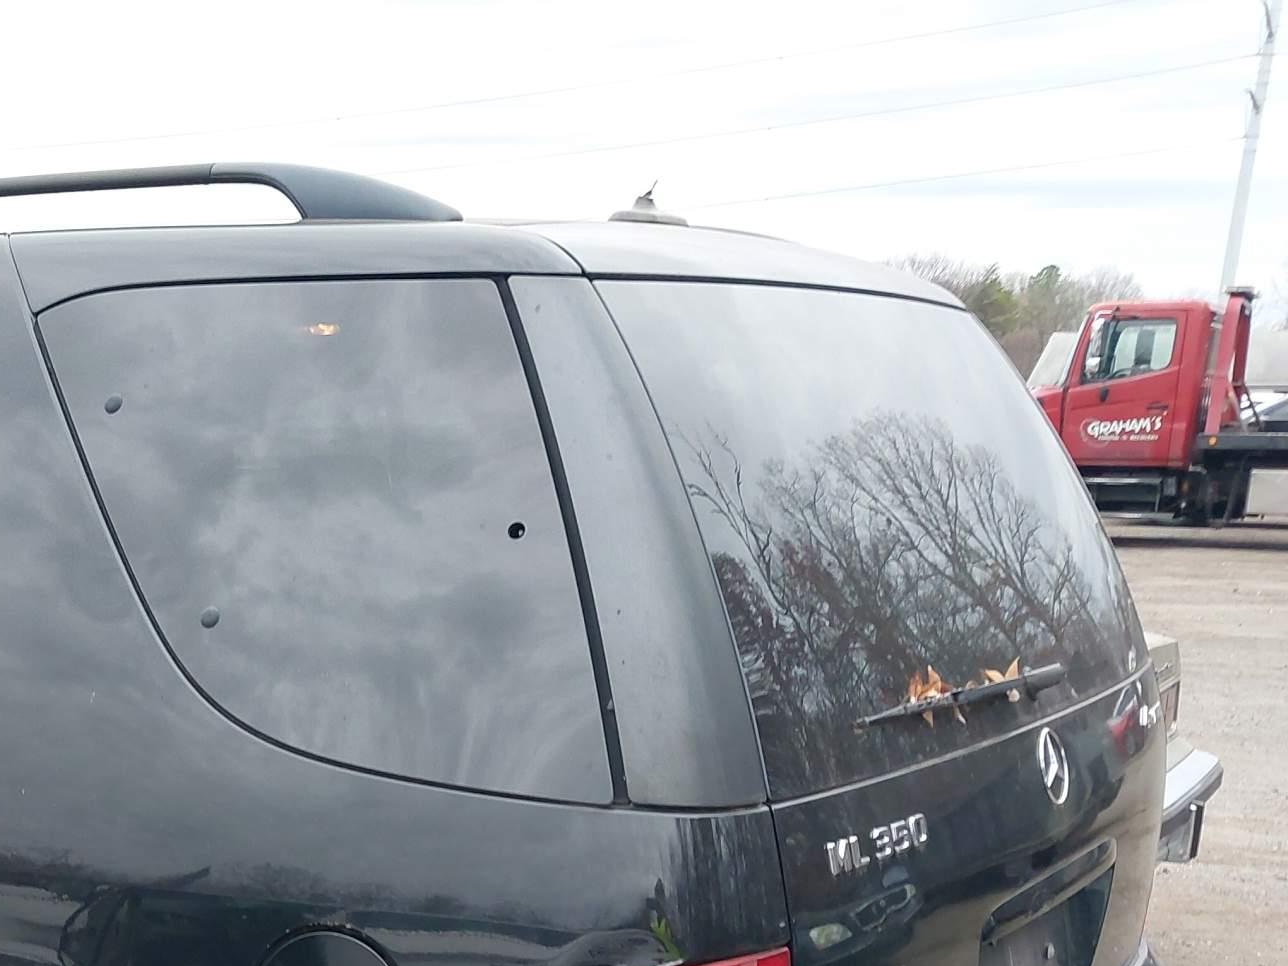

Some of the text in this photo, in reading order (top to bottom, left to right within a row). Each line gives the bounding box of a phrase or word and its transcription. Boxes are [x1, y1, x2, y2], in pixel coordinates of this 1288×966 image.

[1087, 416, 1162, 438] GRAHAM'S
[824, 813, 927, 876] ML 350
